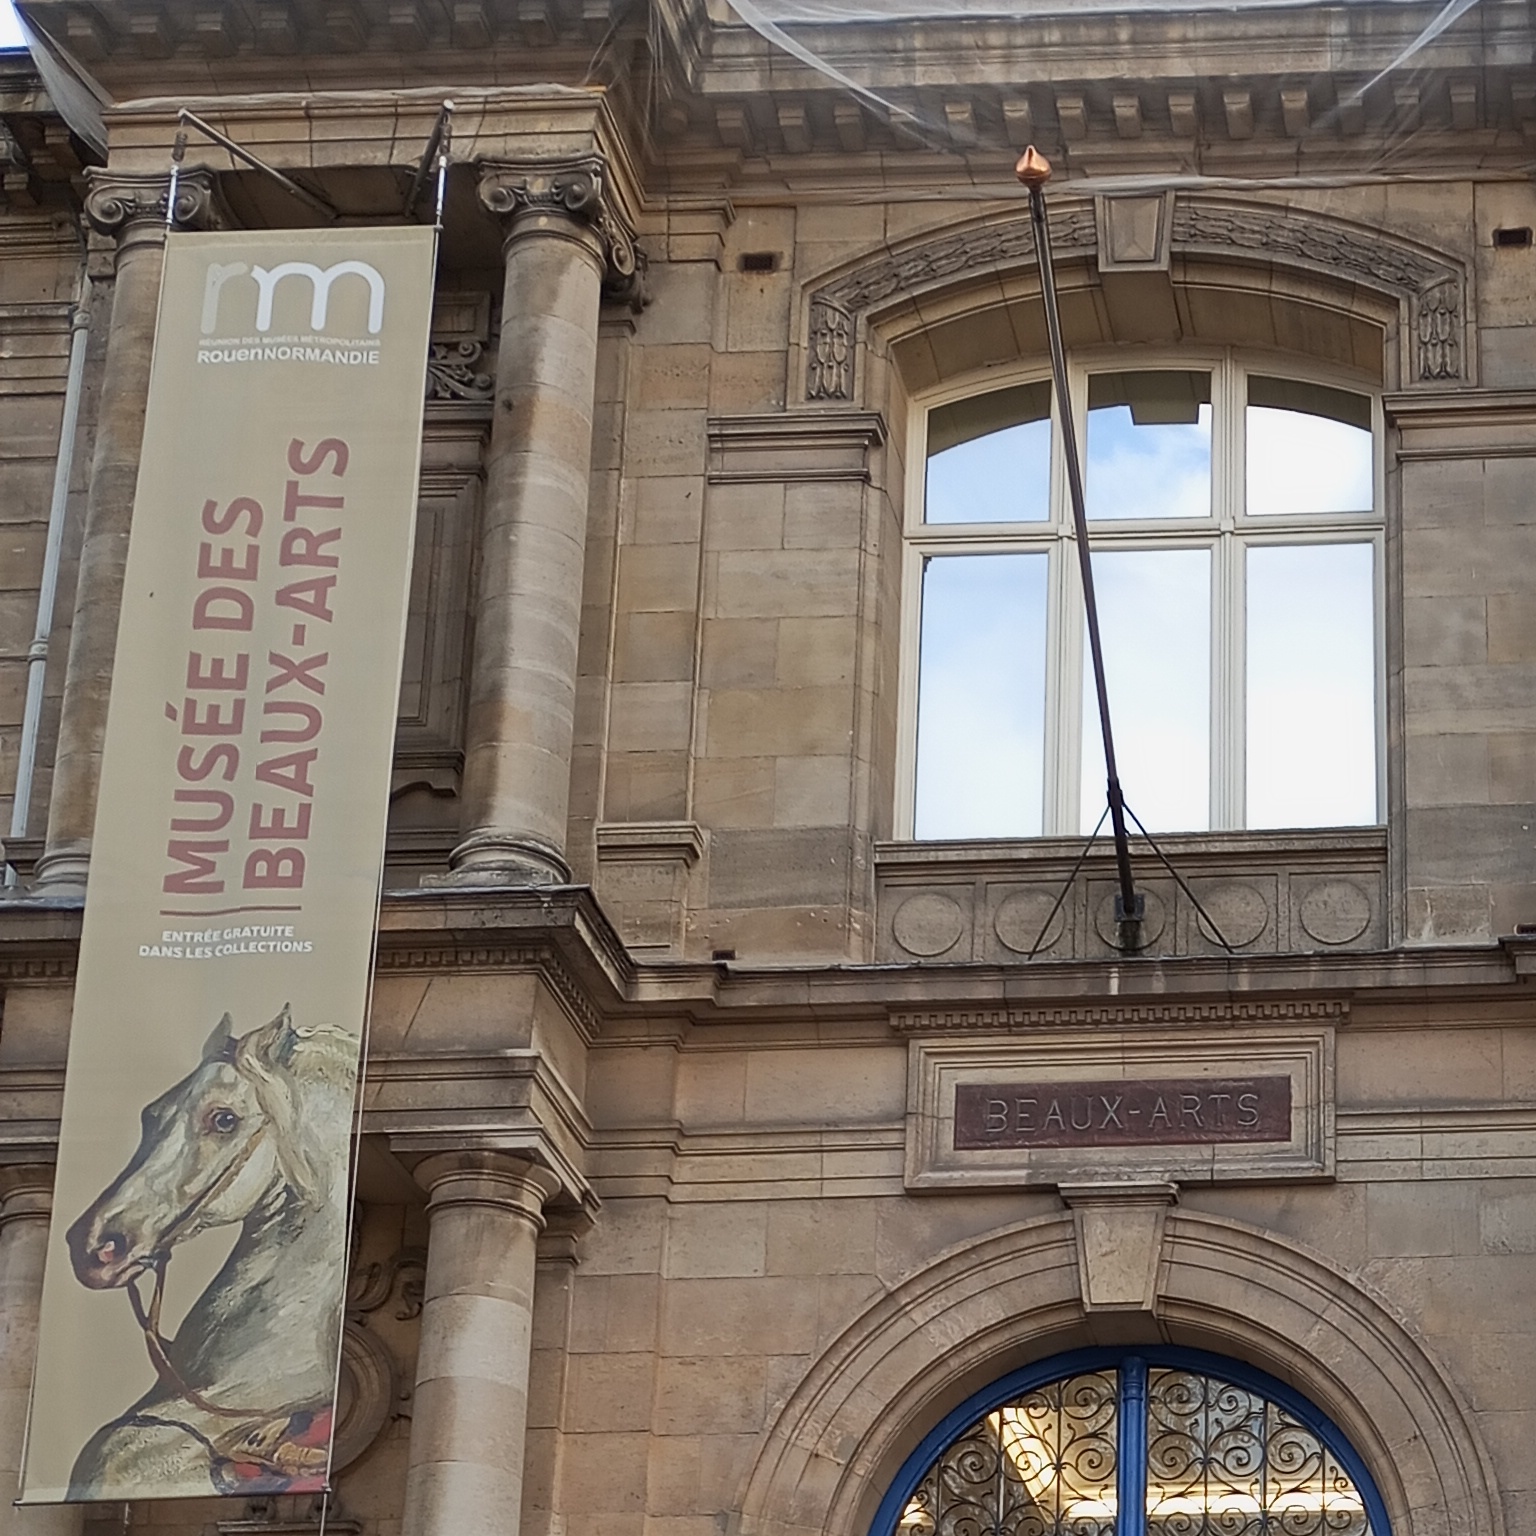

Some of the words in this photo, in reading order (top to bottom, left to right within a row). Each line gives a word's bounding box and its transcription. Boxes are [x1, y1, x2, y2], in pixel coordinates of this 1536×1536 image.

[242, 337, 260, 345] DES
[262, 335, 298, 344] MUSÉES
[301, 335, 381, 347] MÉTROPOLITAINS
[192, 496, 265, 632] DES
[242, 436, 350, 890] BEAUX-ARTS
[163, 650, 252, 894] MUSÉE
[139, 944, 183, 959] DANS
[185, 943, 213, 959] LES
[215, 939, 313, 957] COLLECTIONS
[162, 926, 222, 944] ENTRÉE
[223, 925, 294, 941] GRATUITE
[984, 1093, 1261, 1134] BEAUX-ARTS
